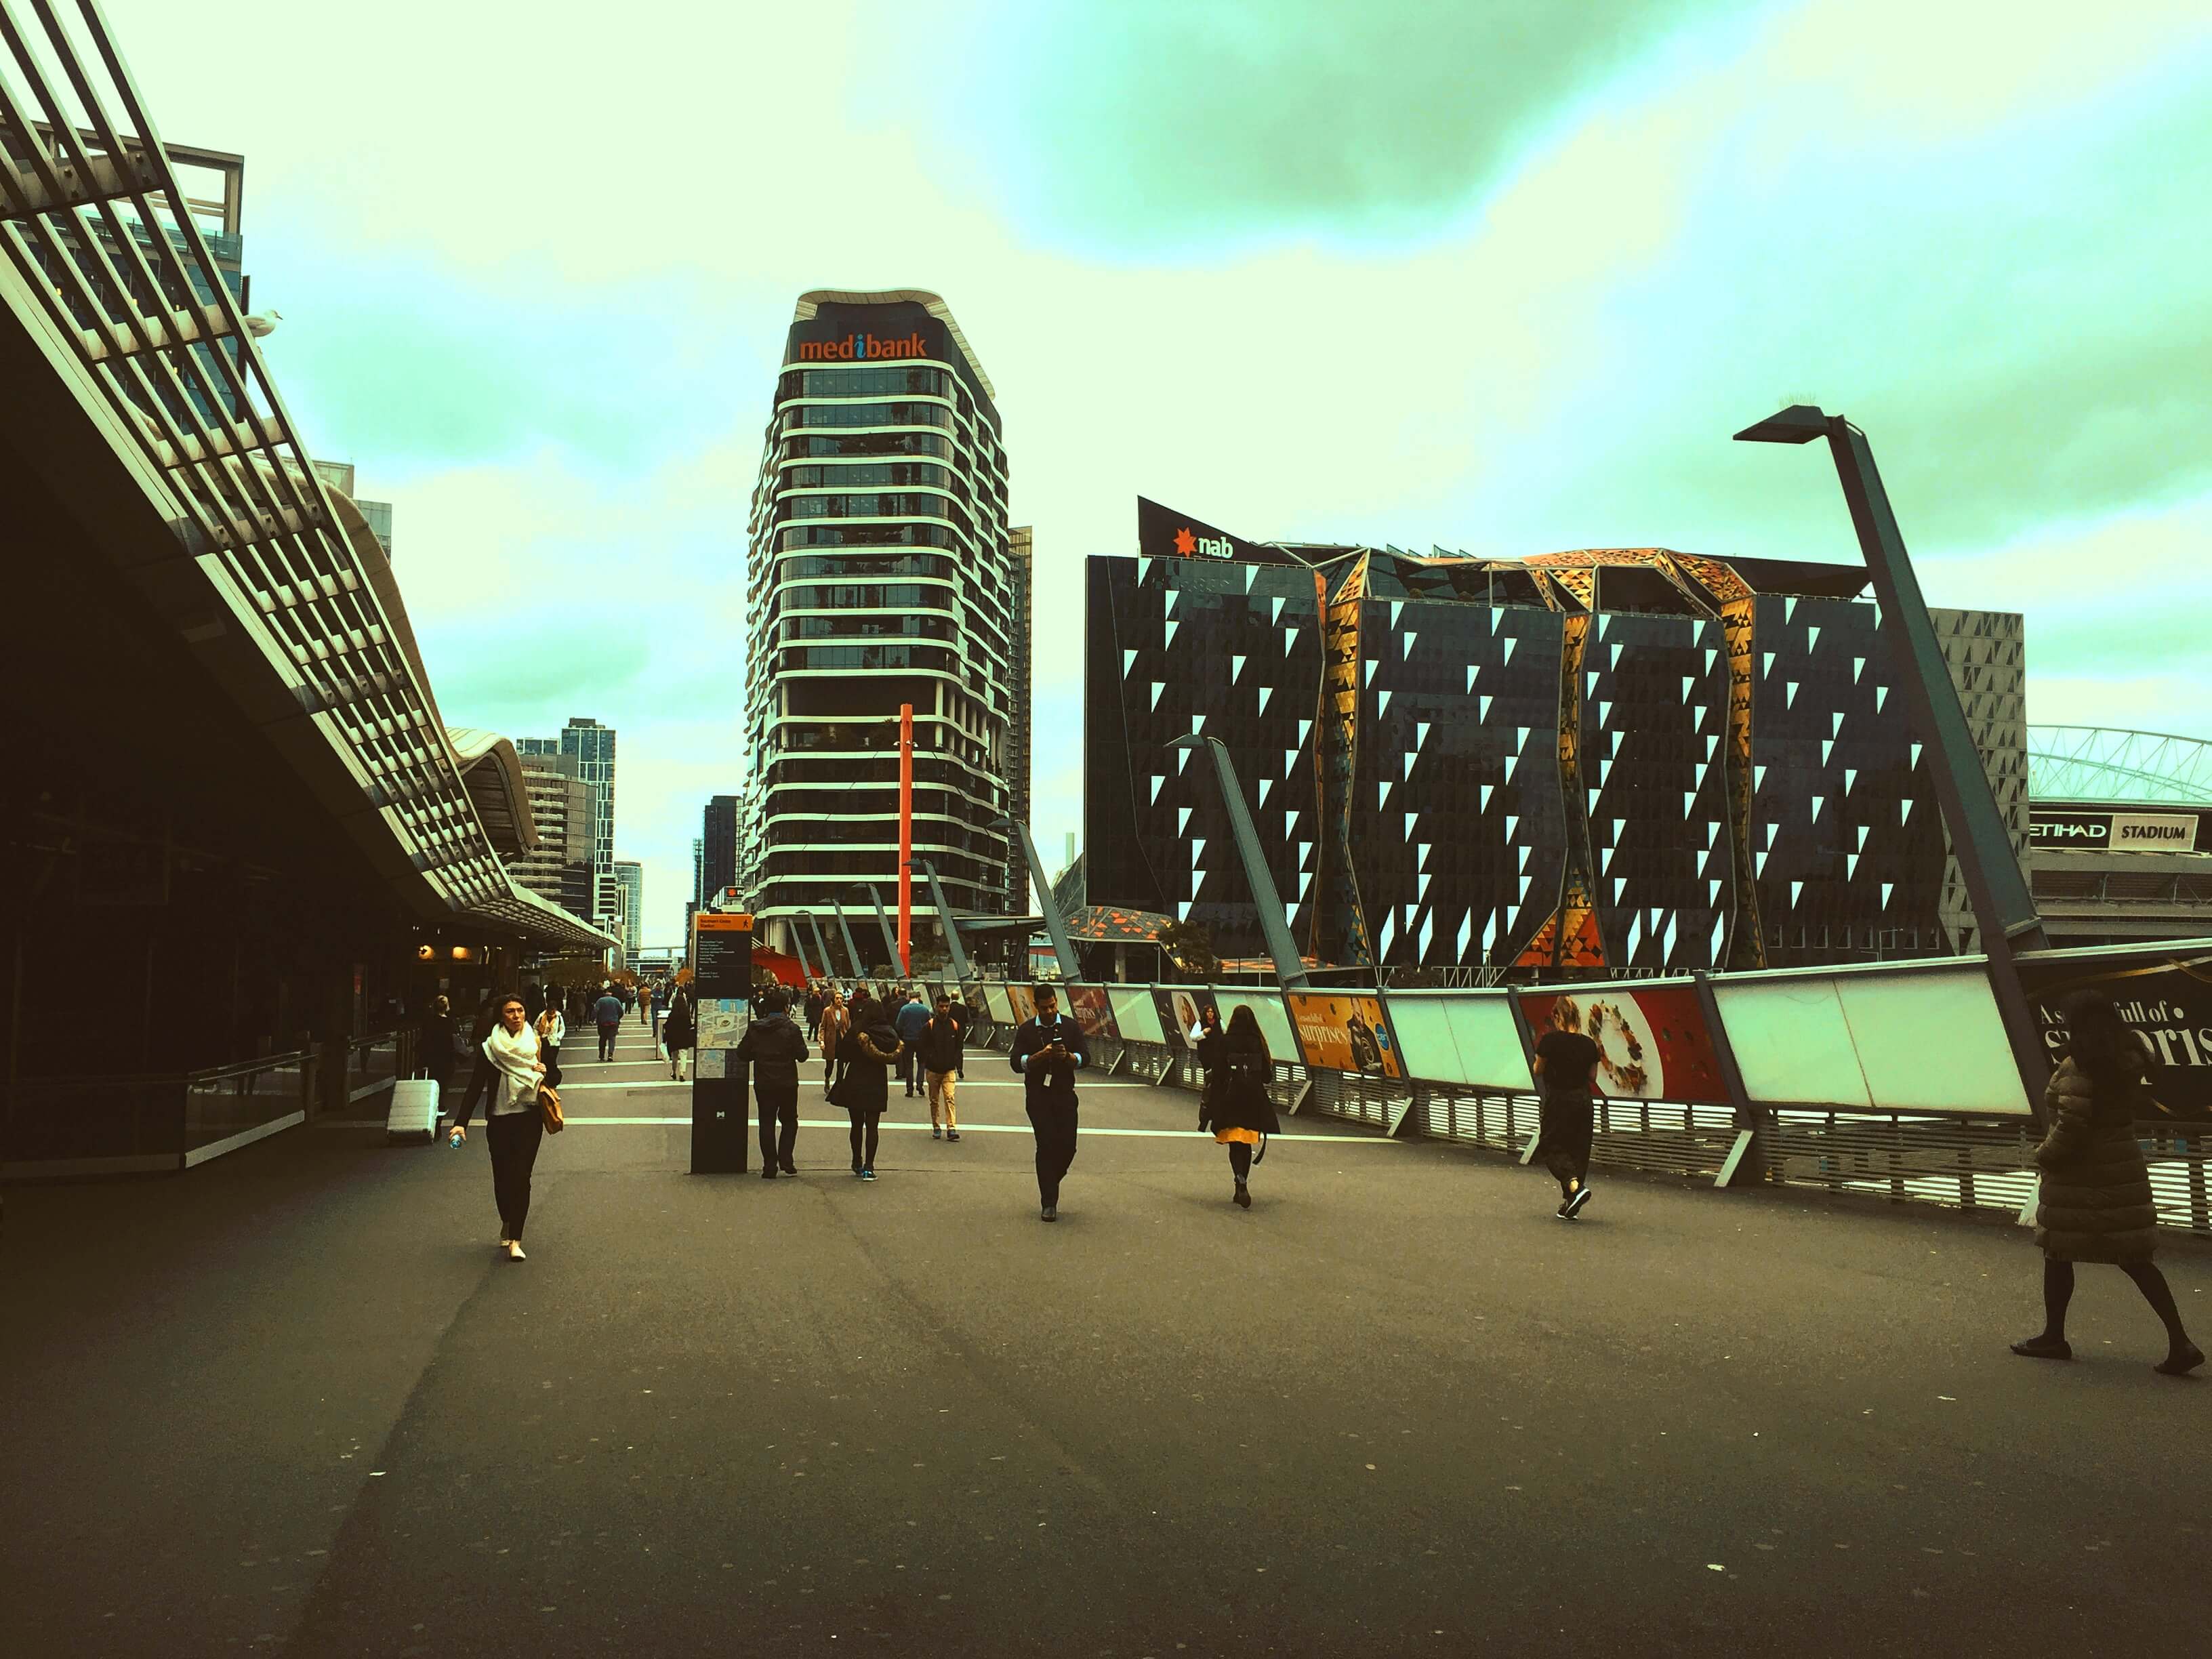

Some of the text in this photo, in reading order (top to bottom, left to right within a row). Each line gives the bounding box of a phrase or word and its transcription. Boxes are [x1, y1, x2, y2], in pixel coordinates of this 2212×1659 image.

[799, 333, 927, 359] medibank
[1198, 537, 1233, 558] nab
[2030, 823, 2185, 840] ETIHAD STADIUM
[2148, 1000, 2170, 1023] of
[1298, 1024, 1349, 1051] surprises
